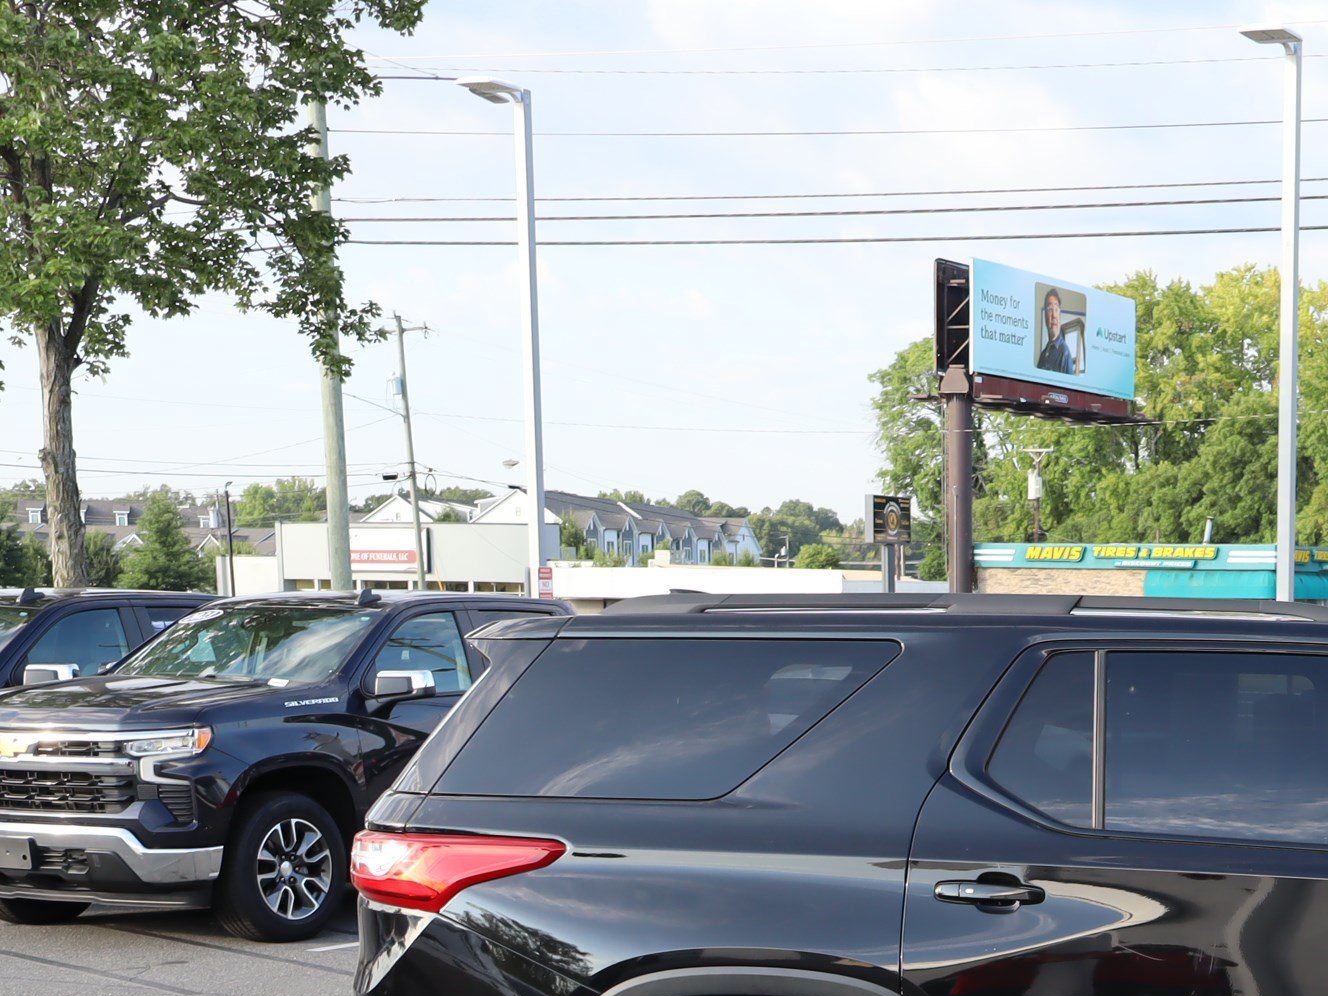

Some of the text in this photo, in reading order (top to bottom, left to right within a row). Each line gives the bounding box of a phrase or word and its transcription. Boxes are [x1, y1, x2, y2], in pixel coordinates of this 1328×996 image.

[981, 289, 1021, 310] Money for
[980, 308, 1029, 330] the moments
[980, 325, 997, 341] that
[1104, 329, 1127, 345] Upstart
[1025, 546, 1216, 561] MAVIS TIRES & BRAKES
[1121, 560, 1162, 568] DISCOUNT
[284, 697, 339, 708] SILVERADO
